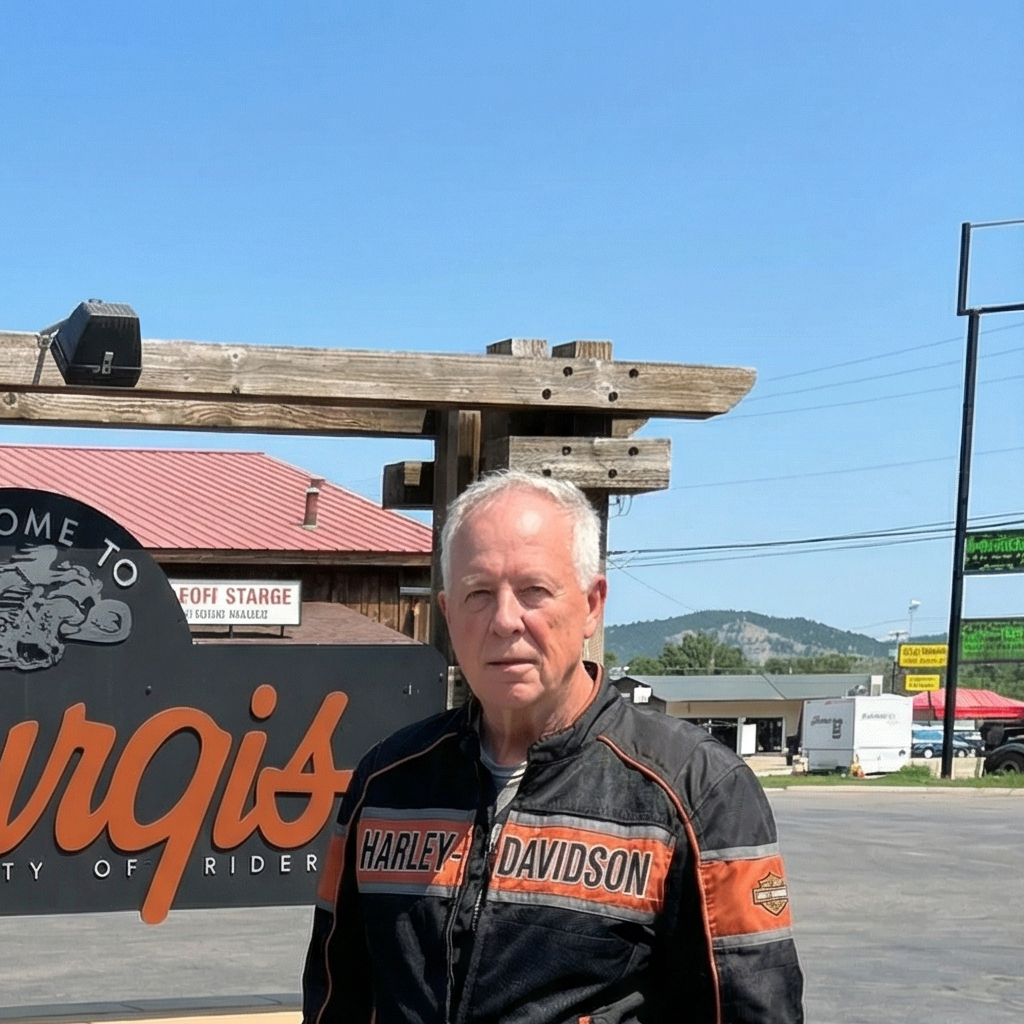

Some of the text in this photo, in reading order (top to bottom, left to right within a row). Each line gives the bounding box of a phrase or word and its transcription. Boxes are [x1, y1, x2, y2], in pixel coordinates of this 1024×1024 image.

[96, 538, 139, 588] TO
[225, 587, 292, 605] STARGE
[94, 858, 139, 879] OF
[359, 828, 653, 899] HARLEY- DAVIDSON
